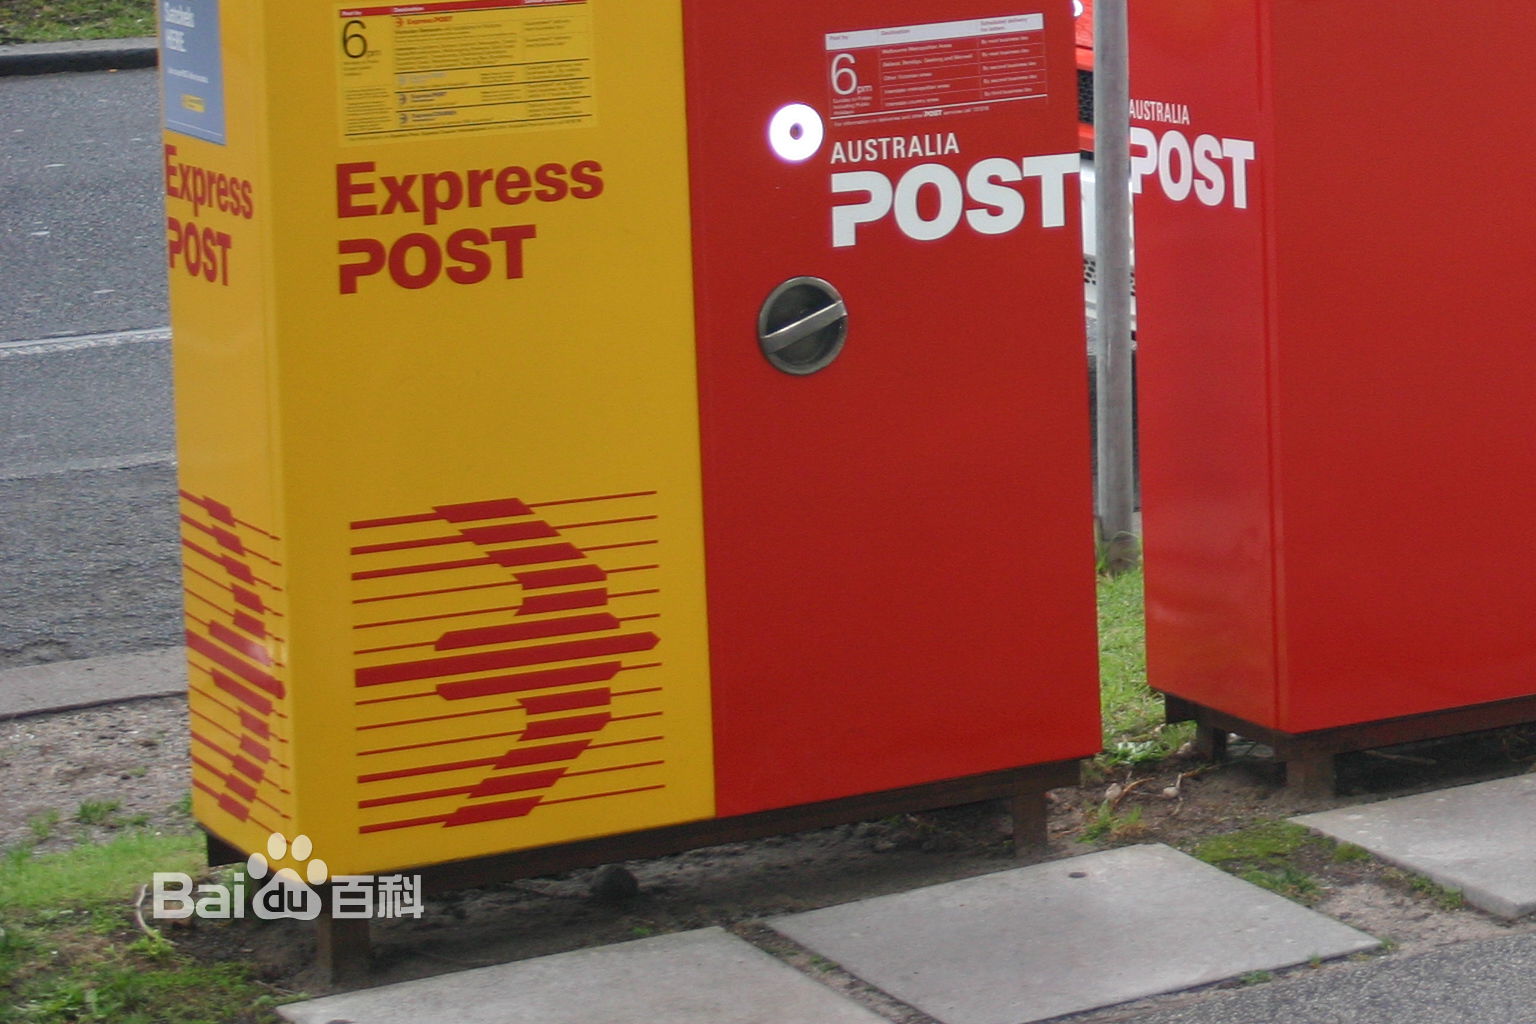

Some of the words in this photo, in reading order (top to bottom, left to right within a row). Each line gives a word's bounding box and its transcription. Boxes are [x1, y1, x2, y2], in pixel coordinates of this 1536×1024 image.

[342, 19, 368, 59] 6
[830, 53, 858, 96] 6
[857, 85, 873, 95] pm
[1129, 98, 1190, 125] AUSTRALIA
[164, 143, 254, 220] Express
[830, 132, 960, 164] AUSTRALIA
[1129, 126, 1255, 209] POST
[336, 160, 604, 225] Express
[831, 153, 1081, 248] POST
[167, 216, 232, 286] POST
[338, 224, 537, 295] POST
